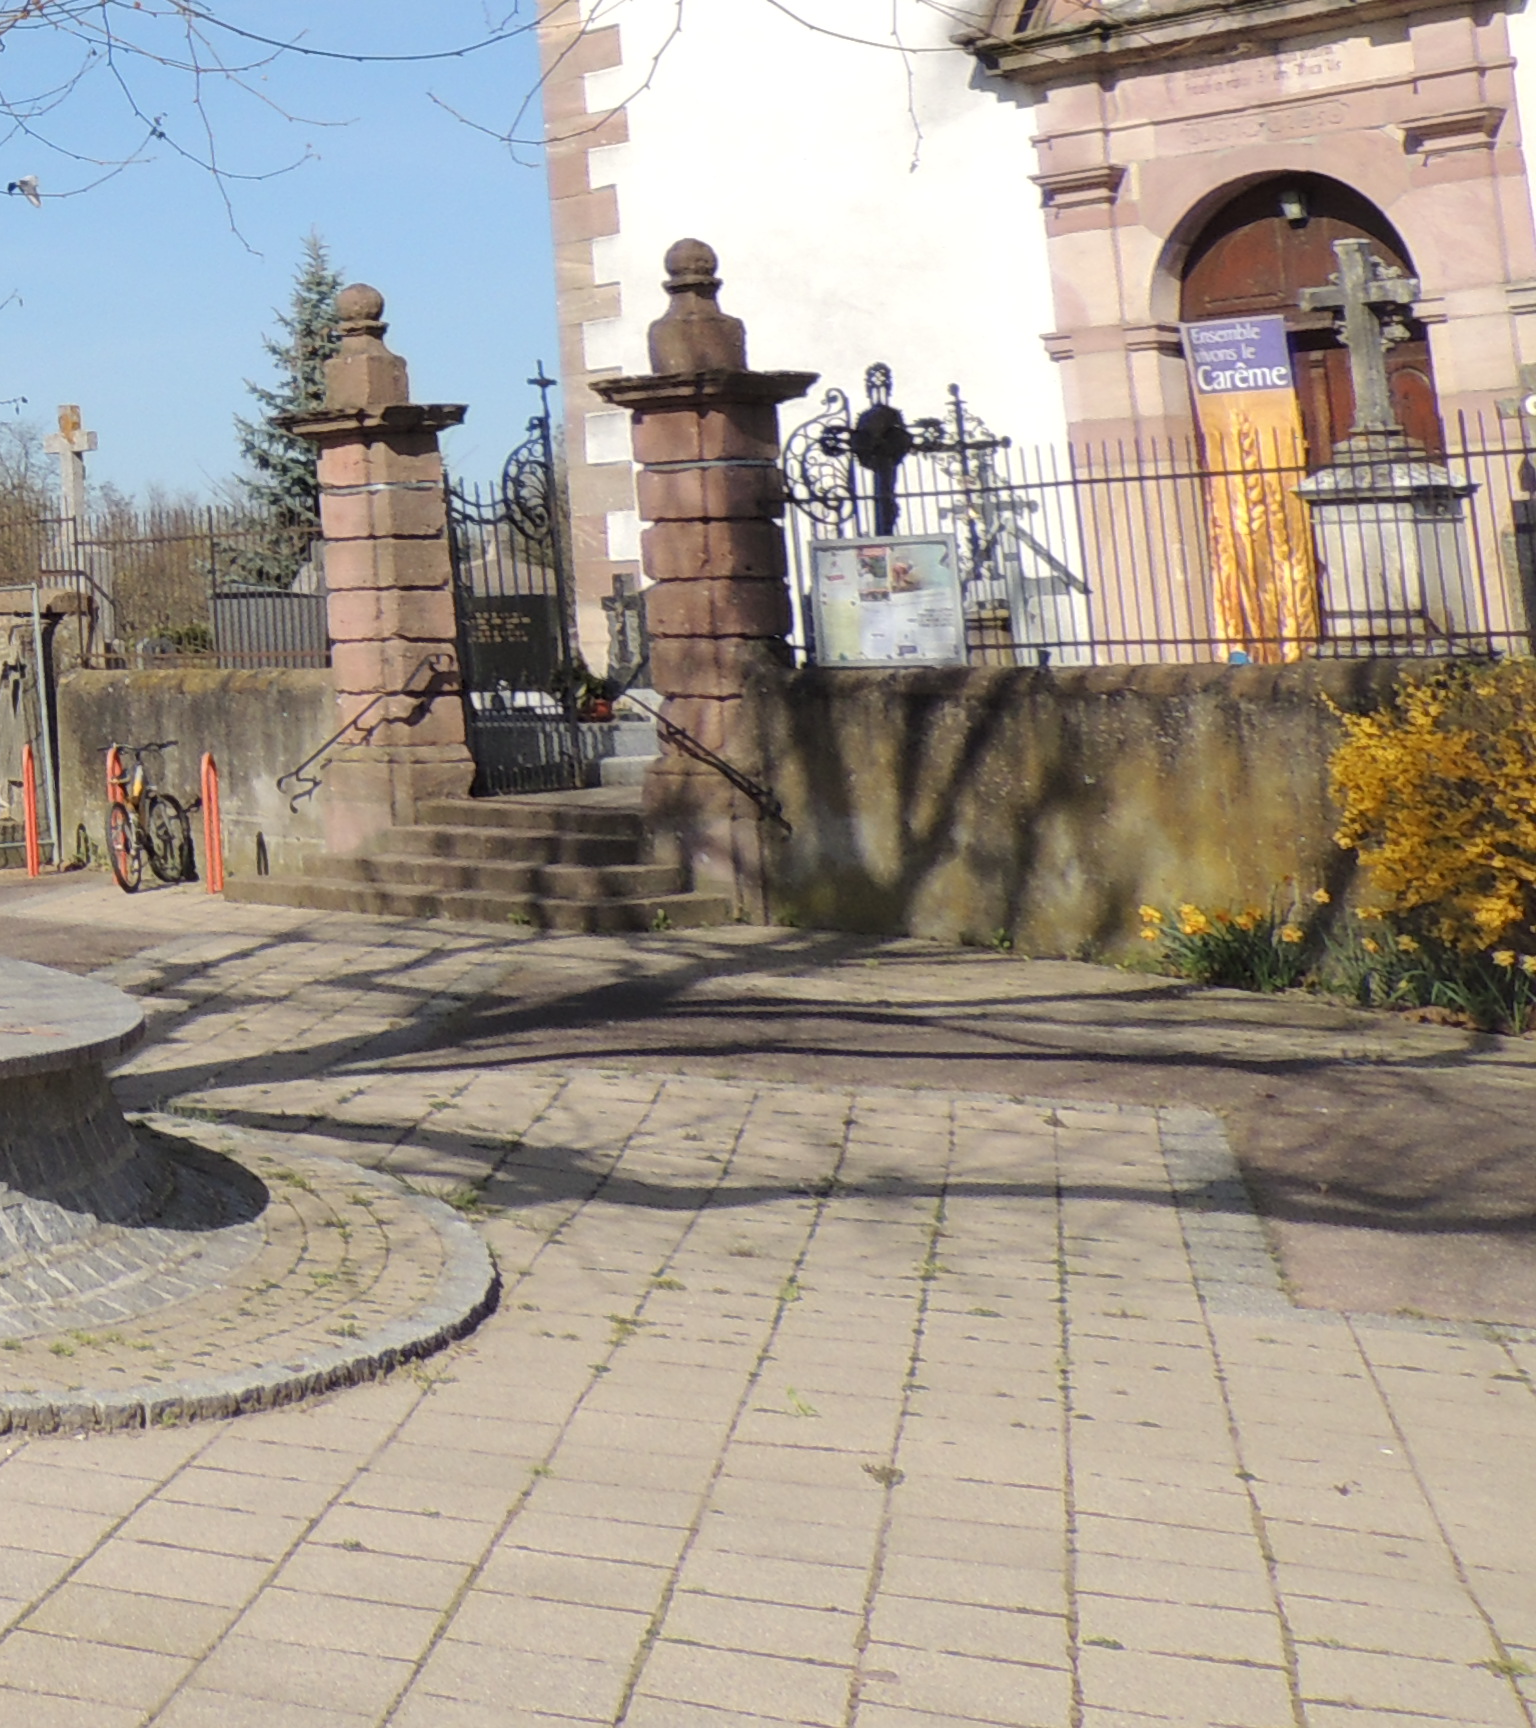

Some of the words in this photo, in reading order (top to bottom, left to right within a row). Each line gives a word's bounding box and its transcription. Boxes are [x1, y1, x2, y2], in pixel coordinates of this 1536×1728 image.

[1190, 323, 1261, 344] Ensemble
[1194, 348, 1238, 363] vivons
[1242, 343, 1256, 359] le
[1197, 361, 1288, 391] Carême
